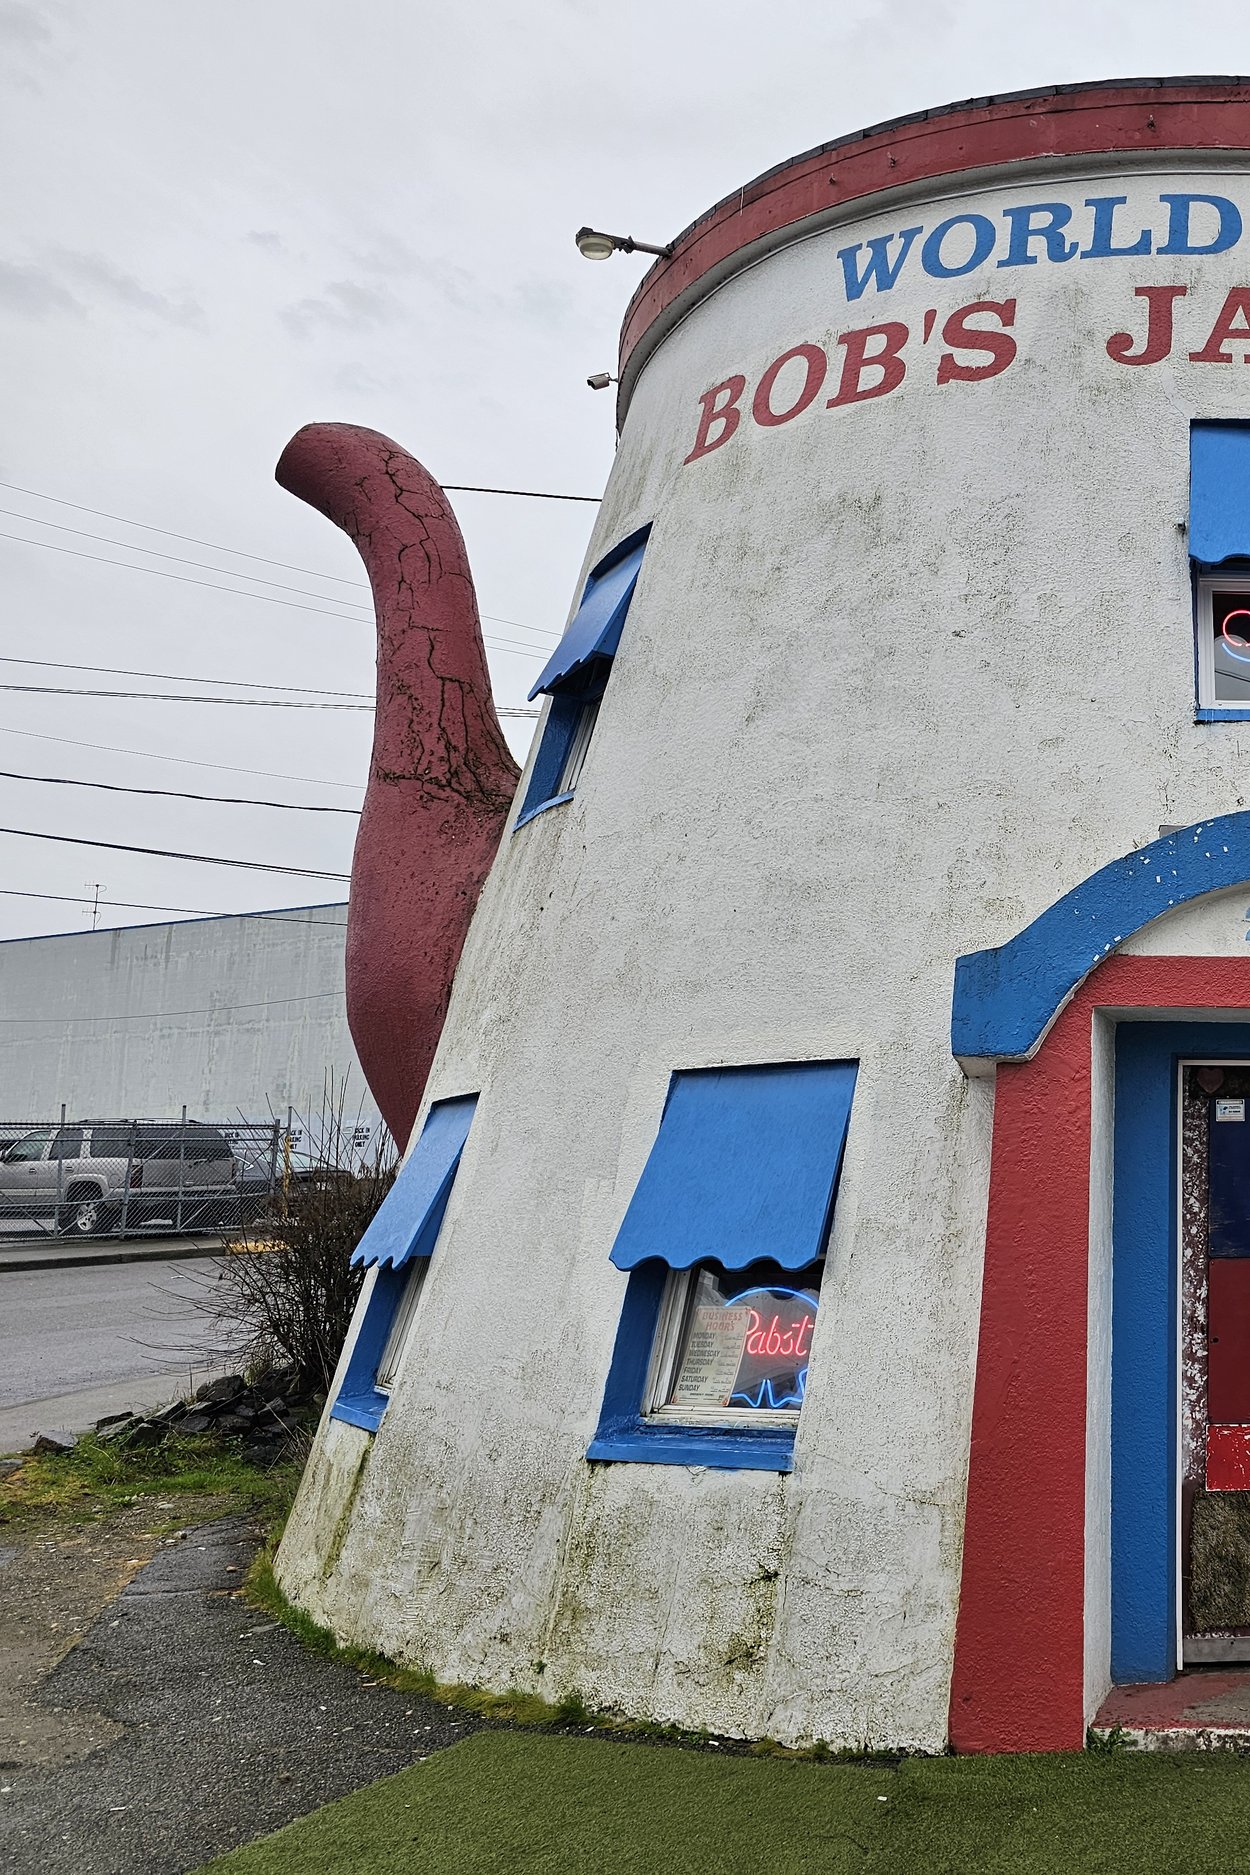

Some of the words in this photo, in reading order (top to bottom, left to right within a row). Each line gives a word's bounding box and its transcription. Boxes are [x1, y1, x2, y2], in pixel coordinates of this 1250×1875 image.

[837, 193, 1243, 301] WORLD
[684, 299, 1017, 465] BOB'S
[703, 1312, 742, 1320] BUSINESS
[746, 1310, 814, 1356] Pabst
